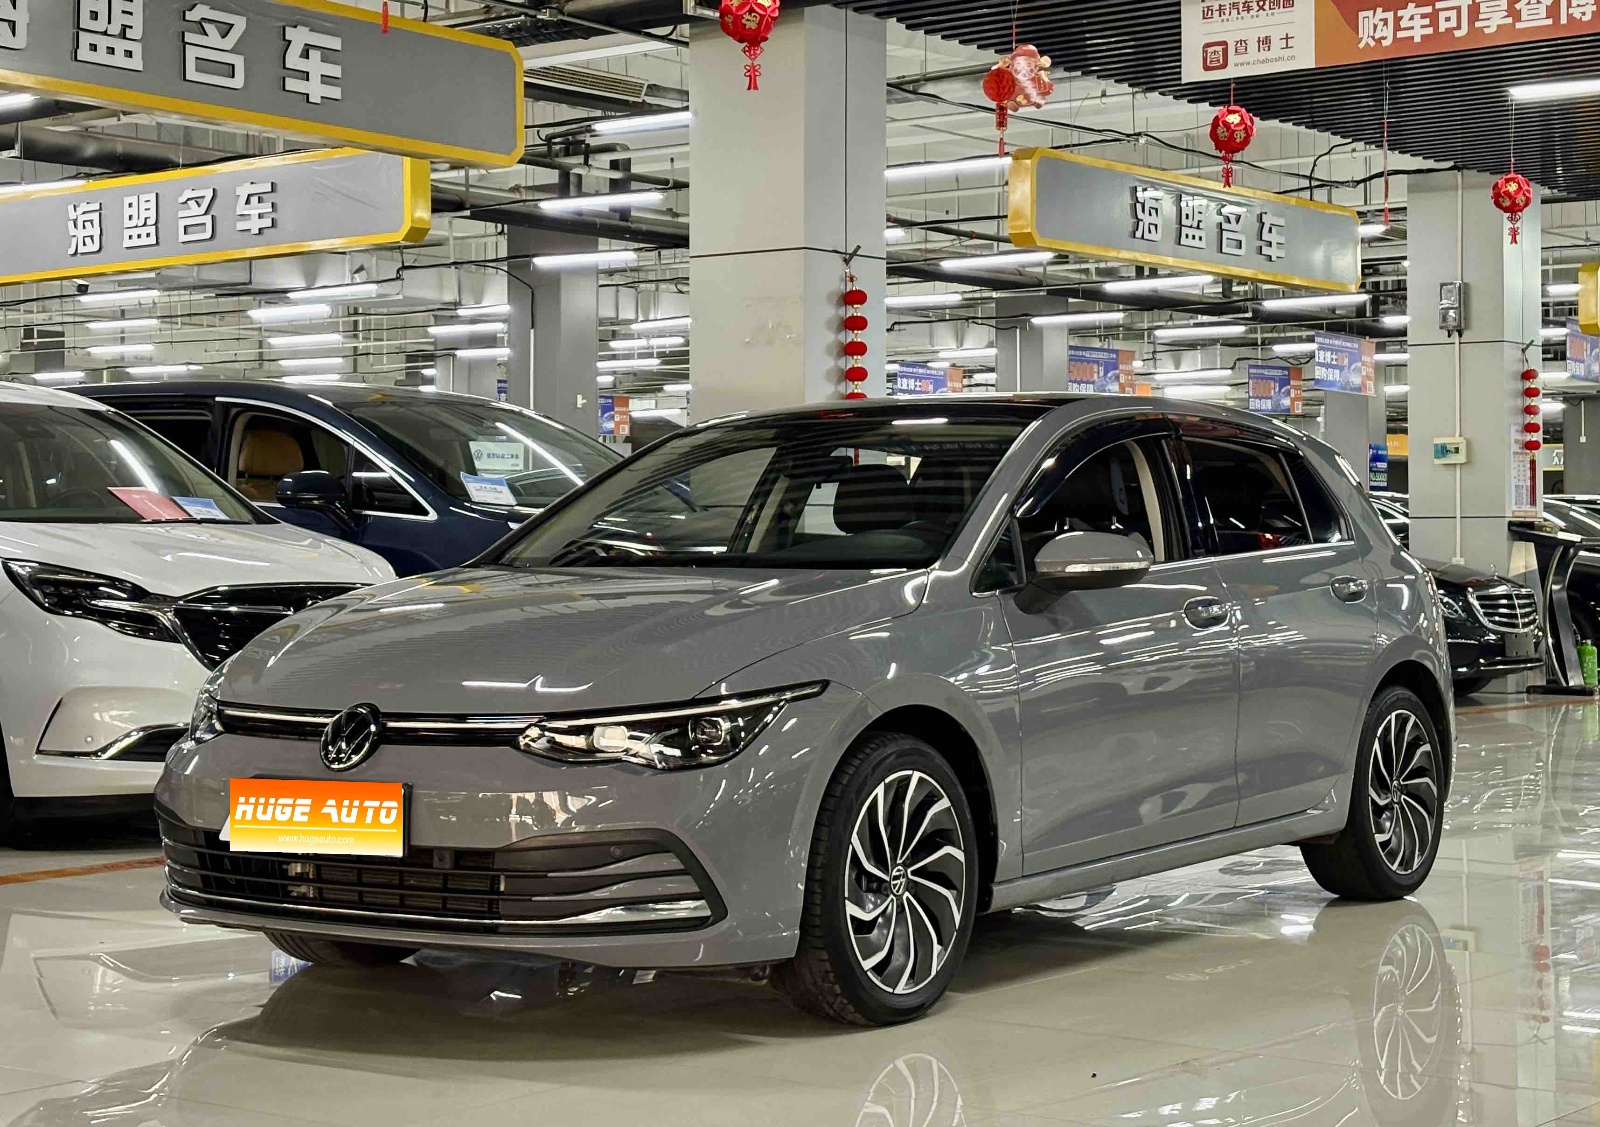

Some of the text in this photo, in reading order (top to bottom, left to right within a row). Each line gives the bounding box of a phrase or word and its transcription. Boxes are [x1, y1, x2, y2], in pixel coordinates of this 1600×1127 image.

[1234, 32, 1295, 56] 查博士
[1234, 54, 1296, 68] www.chaboshi.cn
[67, 181, 277, 256] 海盟名车
